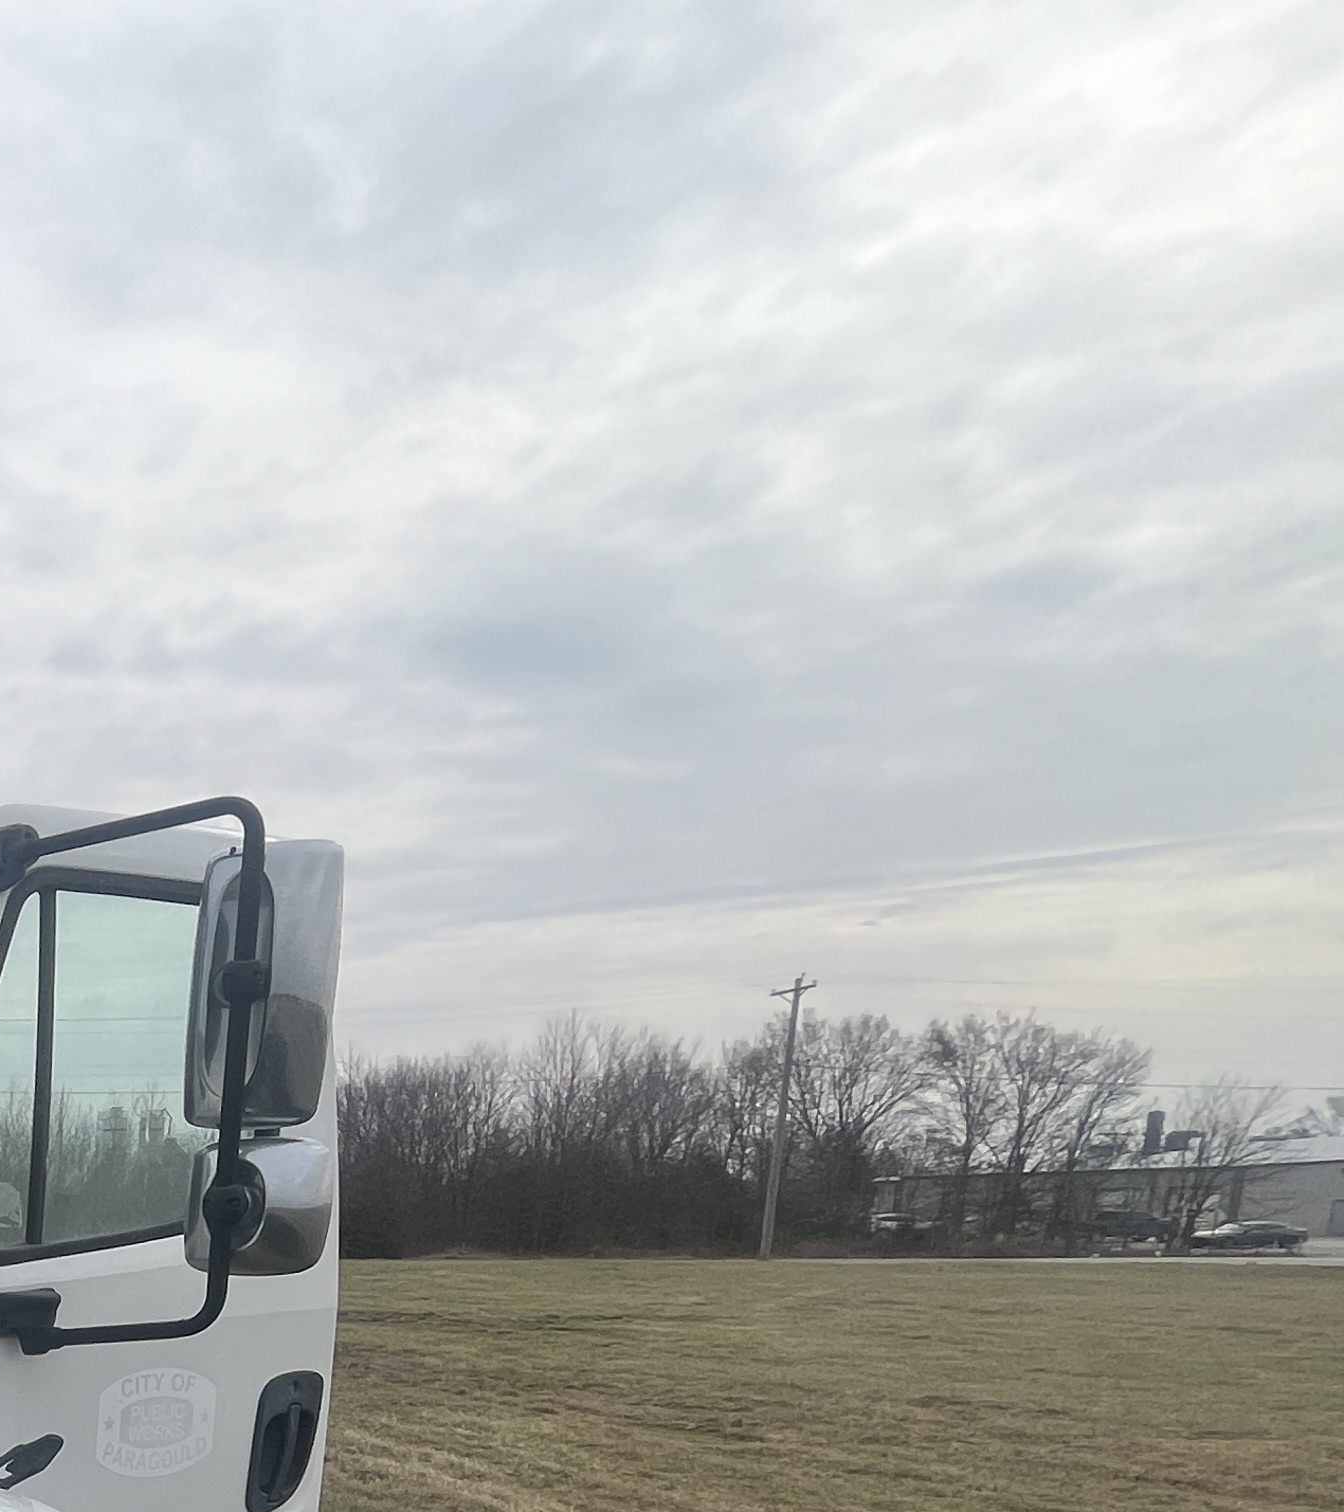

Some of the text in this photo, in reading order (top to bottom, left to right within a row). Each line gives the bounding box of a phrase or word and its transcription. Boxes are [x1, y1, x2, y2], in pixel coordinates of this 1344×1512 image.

[121, 1373, 197, 1397] CITY OF
[102, 1436, 207, 1472] PARAGOULD
